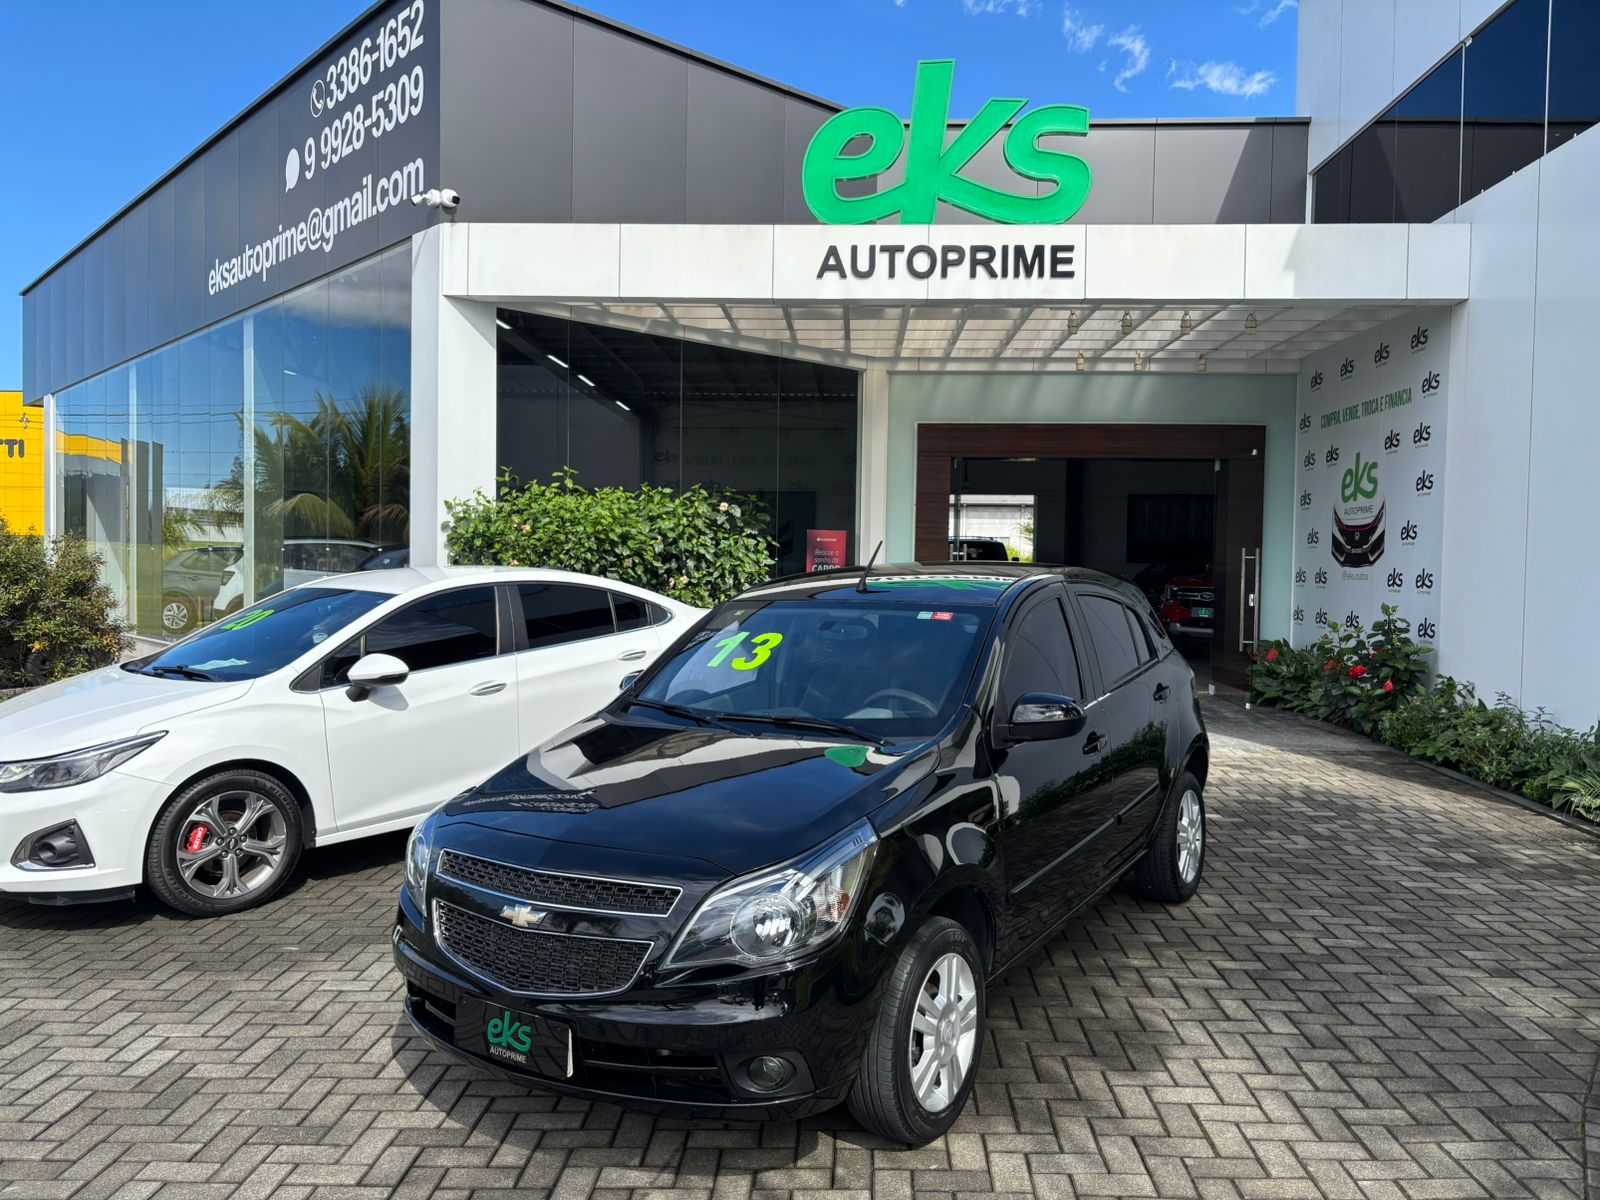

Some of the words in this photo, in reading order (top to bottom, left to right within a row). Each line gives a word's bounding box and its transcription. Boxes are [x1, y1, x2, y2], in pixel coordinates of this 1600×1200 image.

[326, 0, 424, 110] 3386-1652
[304, 136, 316, 180] 9
[321, 65, 424, 170] 9928-5309
[802, 58, 1093, 225] eks
[208, 158, 424, 296] eksautoprime@gmail.com
[816, 244, 1075, 280] AUTOPRIME
[1374, 342, 1390, 364] eks
[1410, 326, 1428, 350] eks
[1310, 369, 1323, 389] eks
[1340, 357, 1354, 378] eks
[1421, 370, 1440, 394] eks
[1361, 396, 1379, 416] TROCA
[1379, 395, 1385, 412] E
[1384, 387, 1412, 410] FINANCIA
[0, 438, 25, 459] TI
[1341, 452, 1378, 502] eks
[706, 631, 784, 671] 13
[487, 1010, 532, 1053] eks
[489, 1045, 527, 1064] AUTOPRIME
